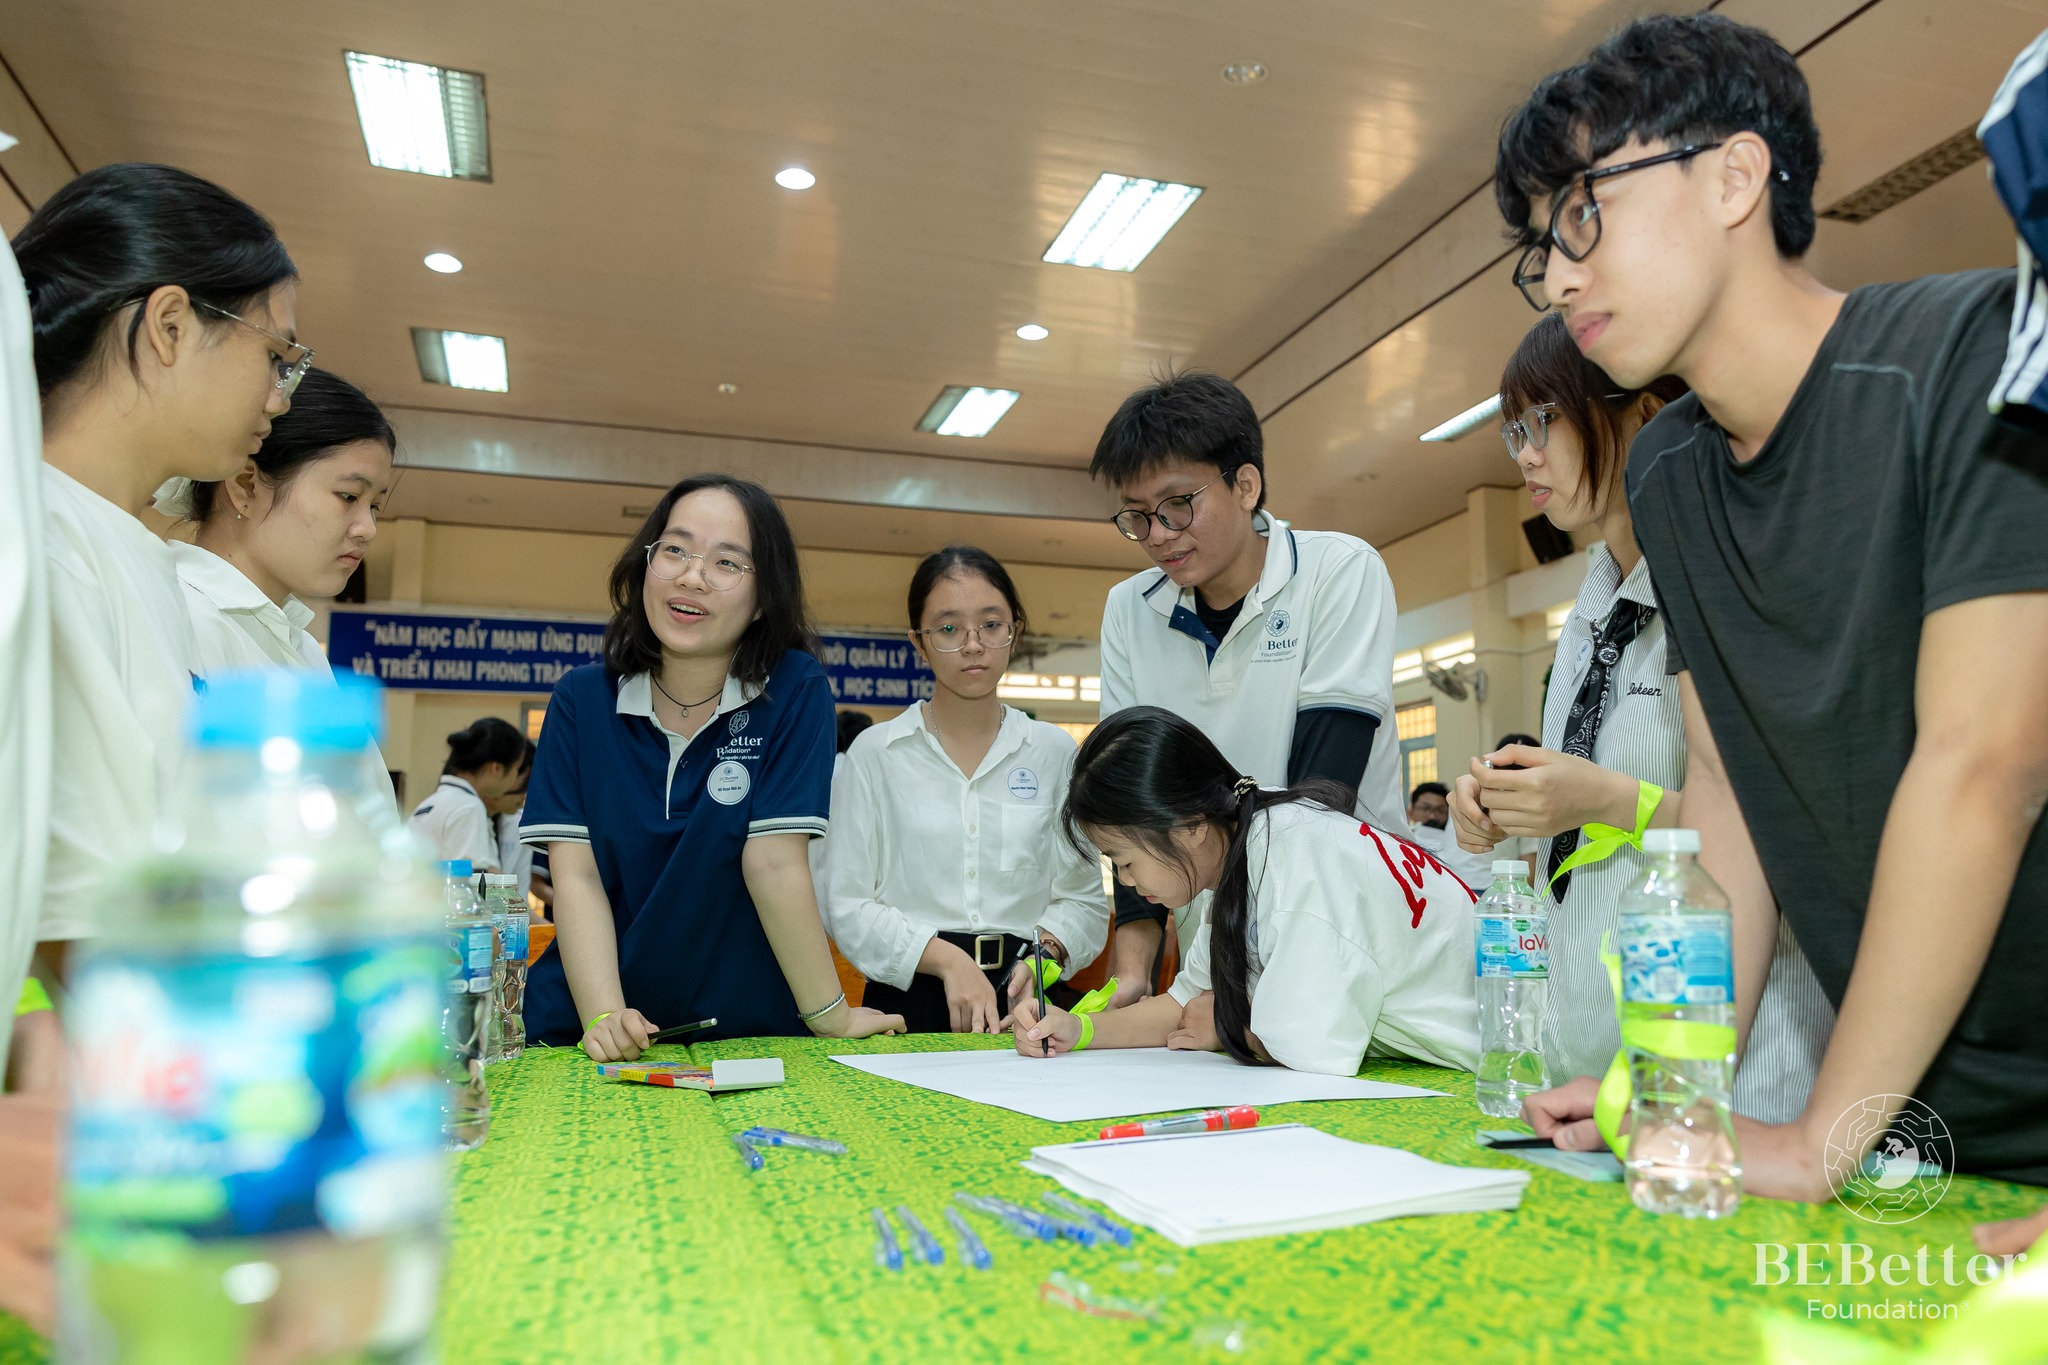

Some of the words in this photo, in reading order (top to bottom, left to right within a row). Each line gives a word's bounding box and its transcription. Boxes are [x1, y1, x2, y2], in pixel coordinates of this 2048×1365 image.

[416, 626, 452, 651] HỌC
[453, 619, 488, 650] ĐẨY
[491, 629, 538, 656] MẠNH
[540, 625, 574, 653] ỨNG
[848, 641, 887, 669] QUẢN
[889, 646, 908, 669] LÝ
[351, 652, 376, 677] VÀ
[378, 649, 430, 680] TRIỂN
[433, 659, 472, 681] KHAI
[475, 660, 530, 684] PHONG
[843, 676, 874, 700] HỌC
[876, 677, 909, 698] SINH
